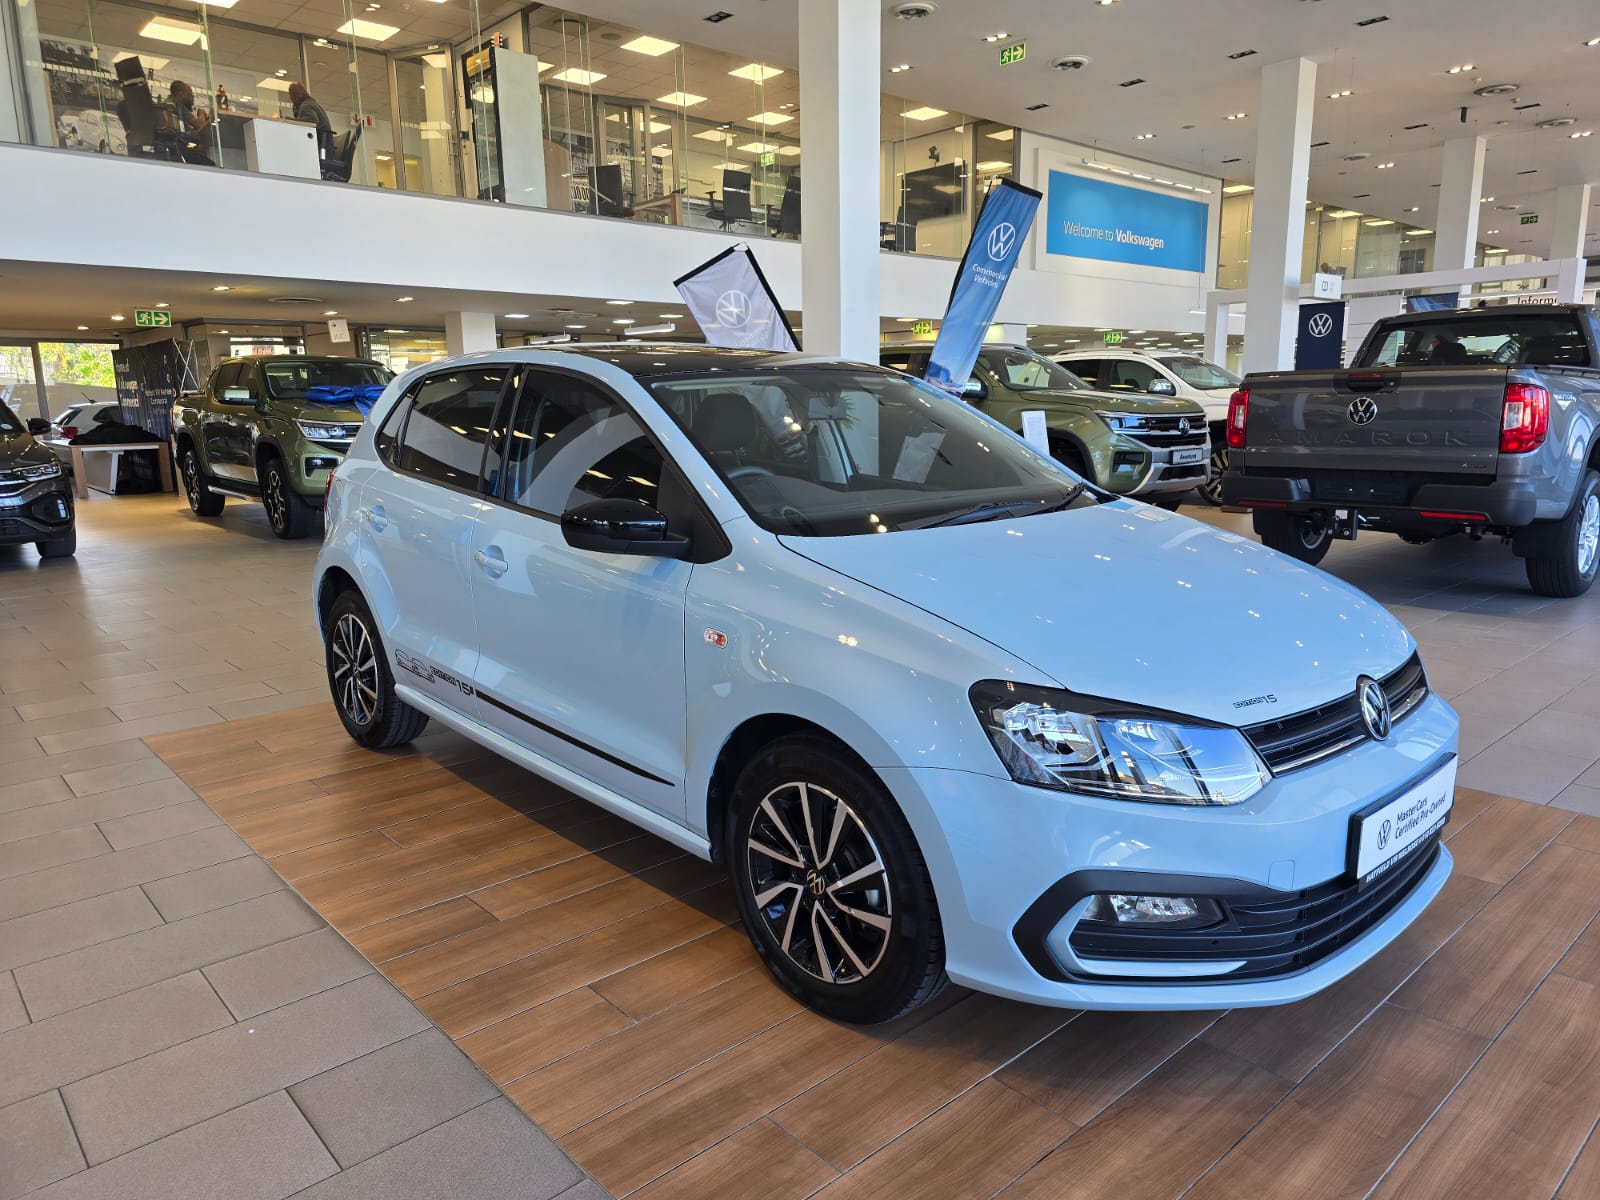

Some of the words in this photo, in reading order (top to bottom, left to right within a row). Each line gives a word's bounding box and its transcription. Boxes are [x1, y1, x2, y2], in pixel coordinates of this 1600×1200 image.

[1063, 220, 1104, 240] Welcome
[1105, 230, 1114, 241] to
[1115, 229, 1164, 250] Volkswagen
[1517, 295, 1557, 305] Inform
[1266, 430, 1468, 446] AMAROK
[1395, 814, 1420, 839] Certified
[1420, 791, 1447, 820] Pre-Owned
[1396, 796, 1428, 825] MasterCars
